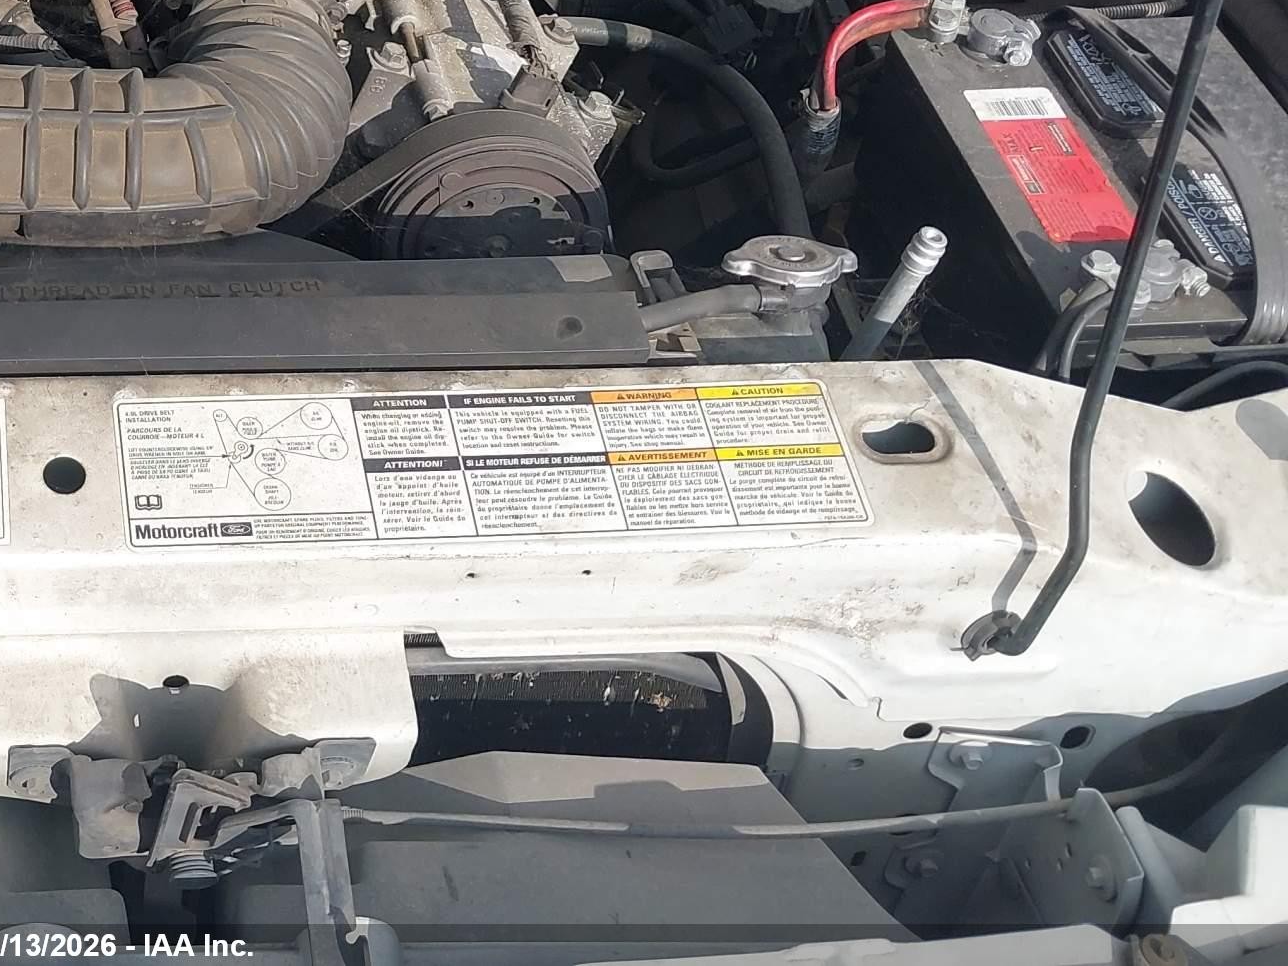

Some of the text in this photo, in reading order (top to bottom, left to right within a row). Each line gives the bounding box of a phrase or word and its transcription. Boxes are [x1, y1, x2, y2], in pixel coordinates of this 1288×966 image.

[1188, 218, 1220, 253] DANGER
[170, 283, 211, 297] FAN
[228, 280, 320, 294] CLUTCH
[626, 391, 672, 400] WARNING
[741, 387, 784, 395] CAUTION
[373, 399, 427, 407] ATTENTION
[747, 446, 822, 456] MISE EN GARDE
[486, 458, 519, 466] MOTEUR
[520, 457, 550, 465] REFUSE
[563, 454, 606, 463] DÉMARRER
[628, 452, 707, 461] AVERTISSEMENT
[384, 459, 443, 468] ATTENTION!
[135, 524, 220, 540] Motorcraft
